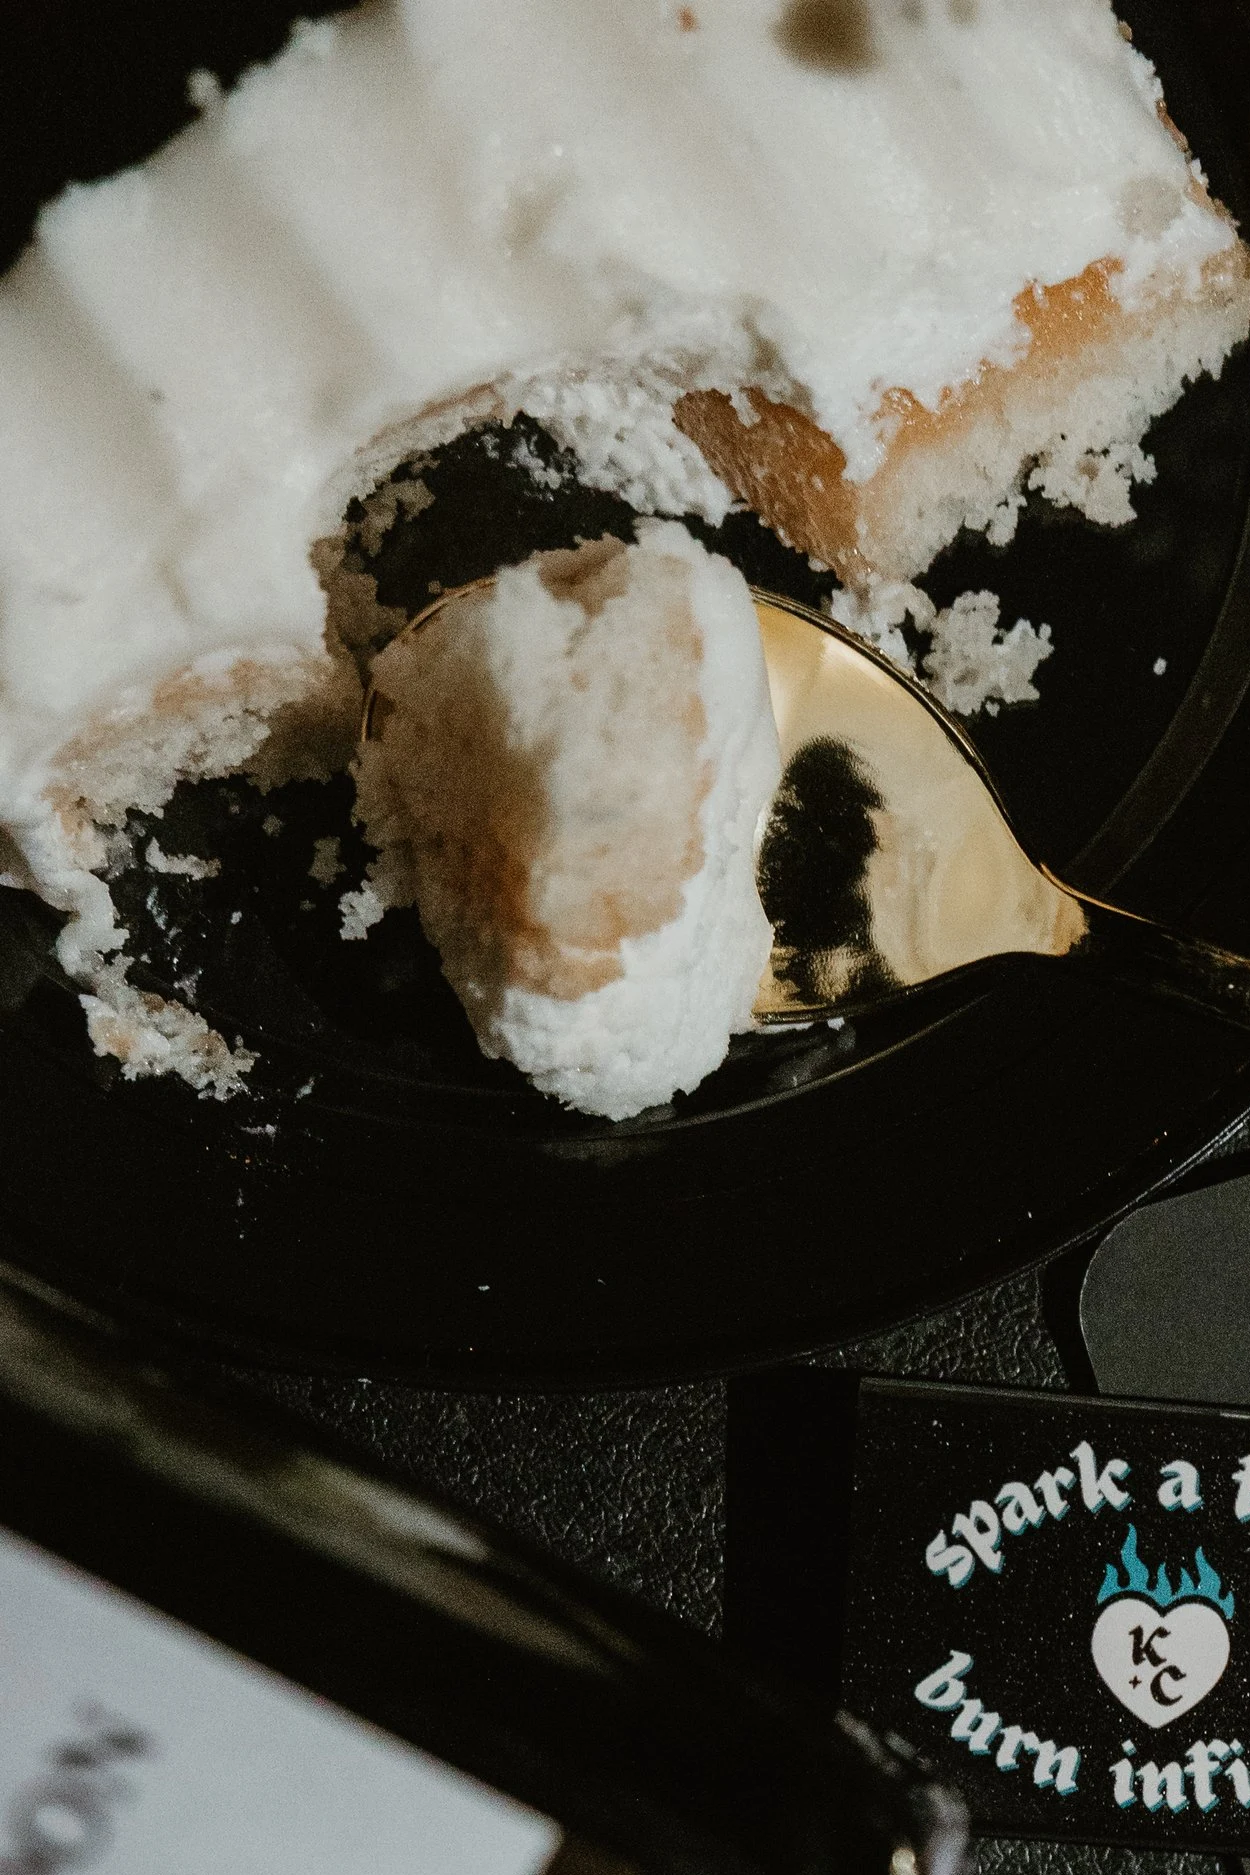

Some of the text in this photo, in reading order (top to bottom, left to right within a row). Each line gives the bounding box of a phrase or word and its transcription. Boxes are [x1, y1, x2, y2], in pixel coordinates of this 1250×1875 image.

[925, 1440, 1132, 1589] spark
[1157, 1457, 1203, 1512] a
[1127, 1624, 1172, 1668] K
[913, 1648, 1081, 1797] burn
